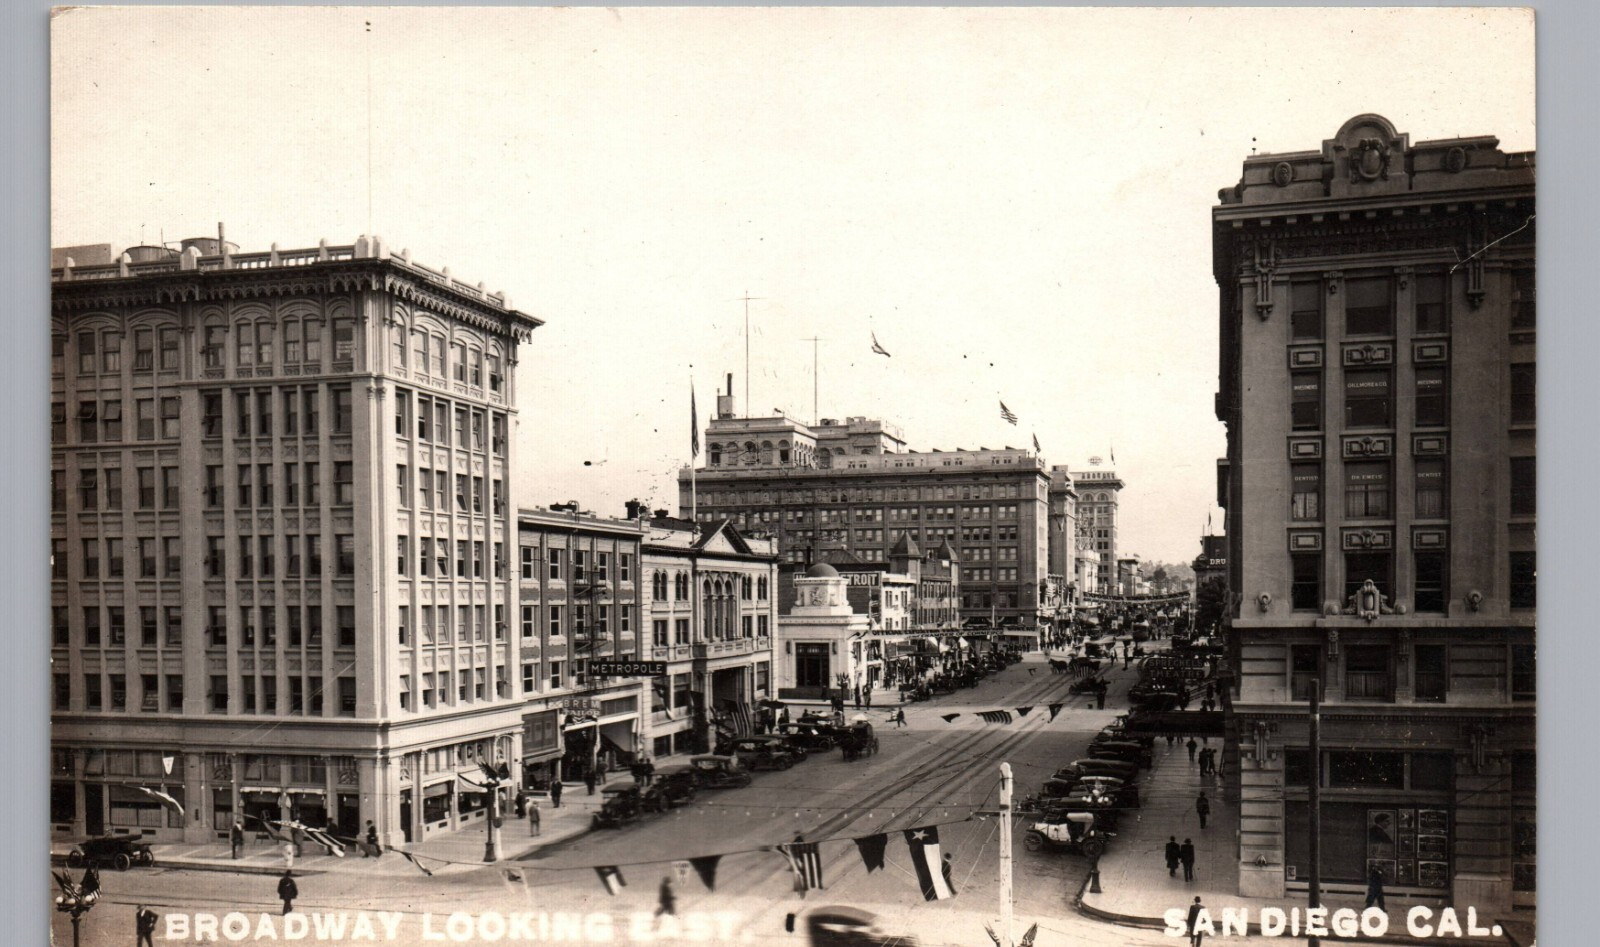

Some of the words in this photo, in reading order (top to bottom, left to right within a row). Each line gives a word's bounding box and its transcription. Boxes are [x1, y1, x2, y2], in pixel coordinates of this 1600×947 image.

[1148, 659, 1203, 667] SPRECKELS
[591, 664, 663, 674] METROPOLE
[1149, 669, 1203, 678] THEATRE
[563, 699, 599, 709] BREM
